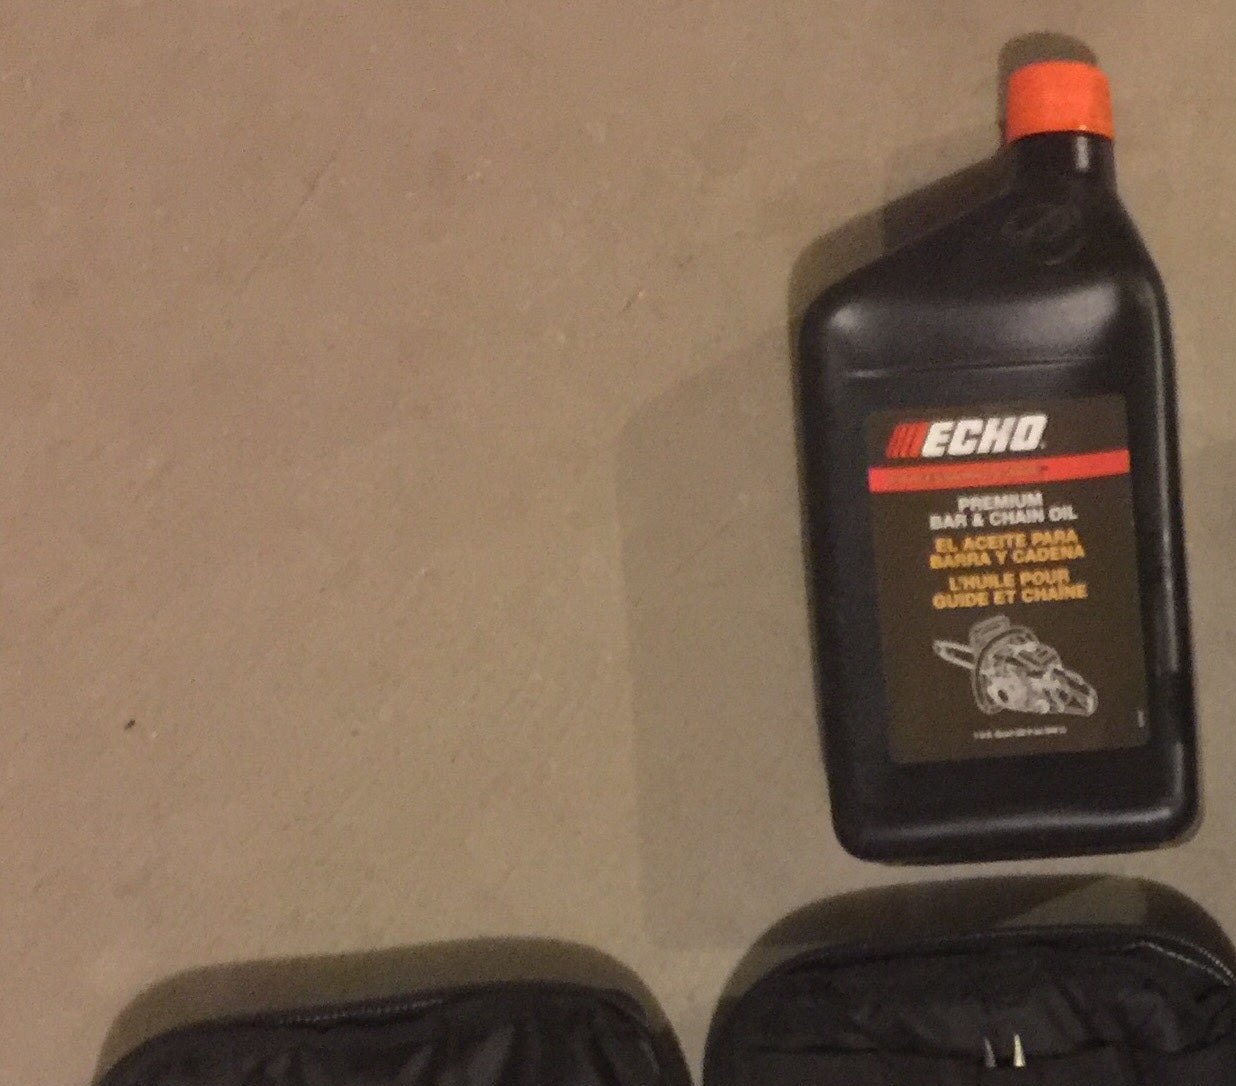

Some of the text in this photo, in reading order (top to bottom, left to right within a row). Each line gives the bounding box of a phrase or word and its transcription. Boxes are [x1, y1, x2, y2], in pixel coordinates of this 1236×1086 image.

[921, 414, 1048, 458] ECHO
[957, 491, 1044, 513] PREMIUM
[929, 504, 1079, 531] BAR & CHAIN OIL
[934, 528, 1080, 553] EL ACEITE PARA
[929, 544, 1086, 570] BARRA Y CADENA
[1019, 567, 1071, 587] POUR
[931, 591, 990, 610] GUIDE
[993, 589, 1017, 606] ET
